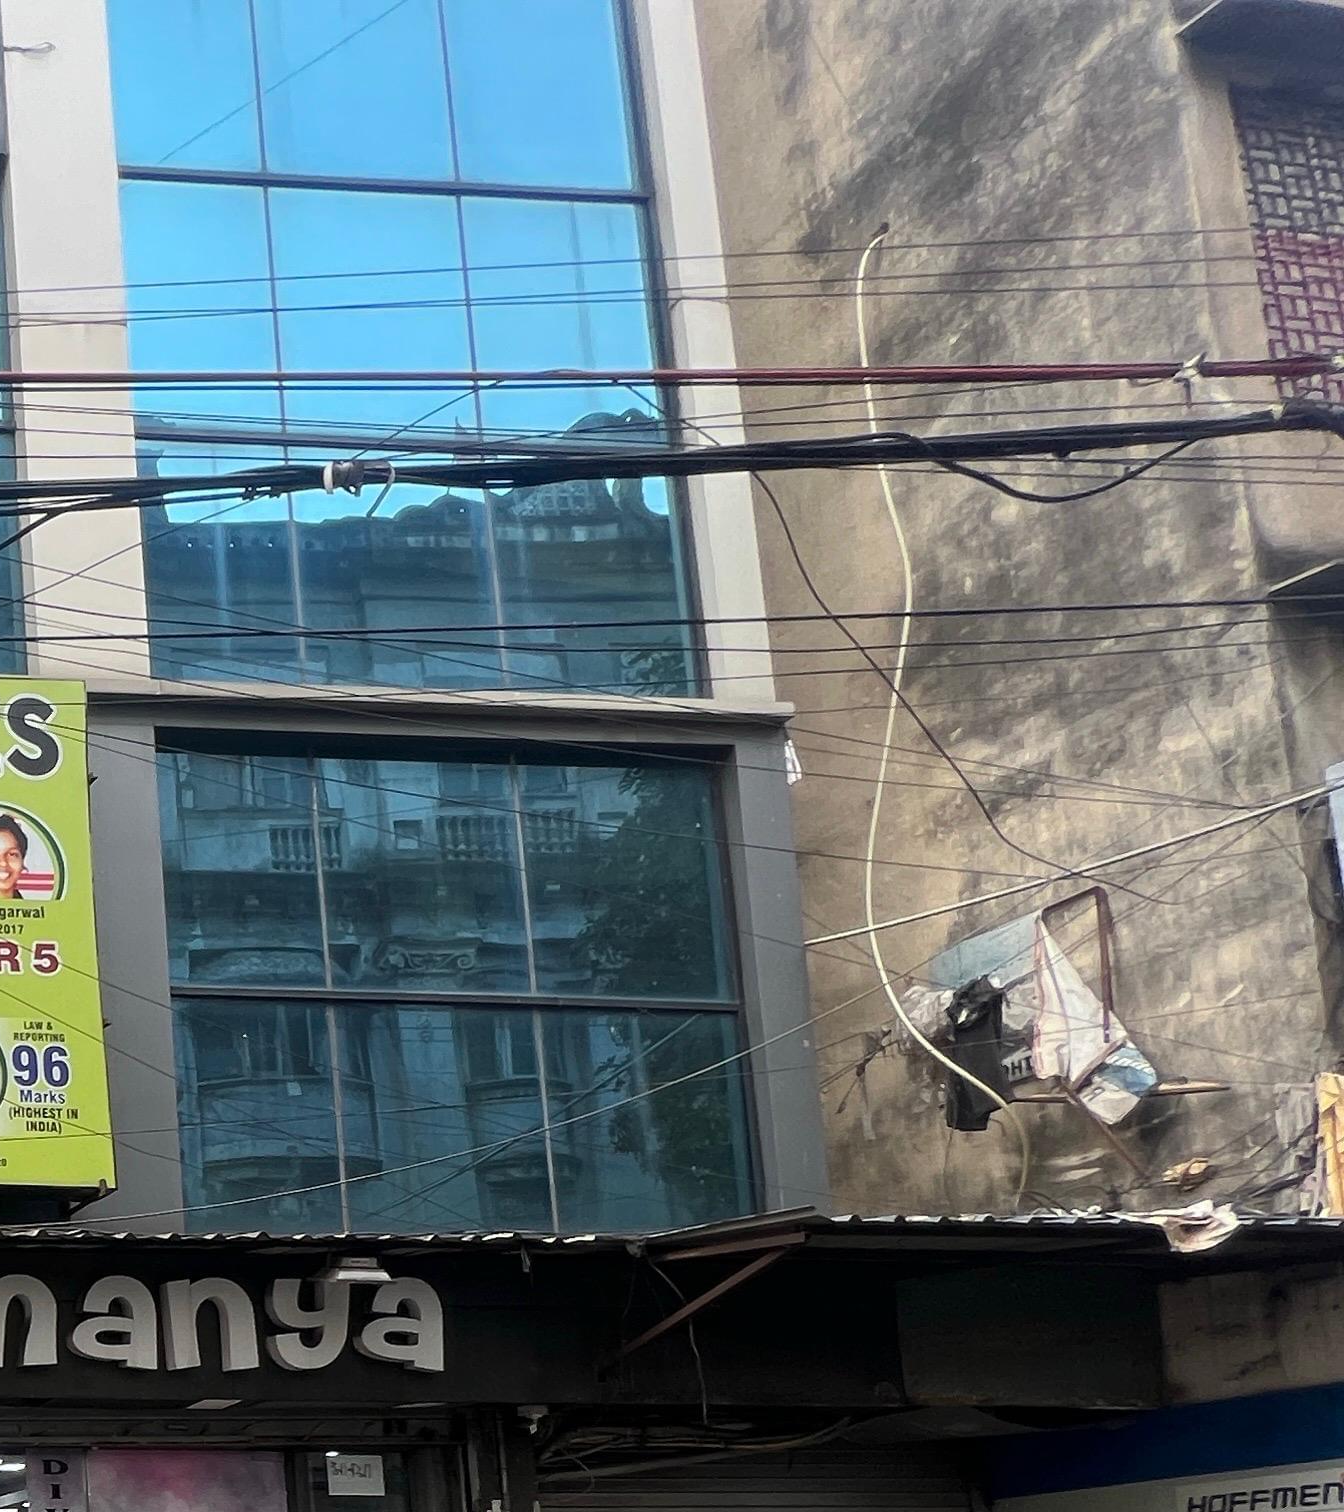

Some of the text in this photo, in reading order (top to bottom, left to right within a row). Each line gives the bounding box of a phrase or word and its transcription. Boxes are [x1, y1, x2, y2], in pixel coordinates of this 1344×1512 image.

[32, 942, 60, 973] 5
[23, 1021, 54, 1031] LAW &
[13, 1031, 66, 1043] REPORTING
[12, 1045, 70, 1088] 96
[19, 1089, 66, 1104] Marks
[8, 1105, 79, 1120] (HIGHEST IN
[25, 1120, 63, 1135] INDIA)
